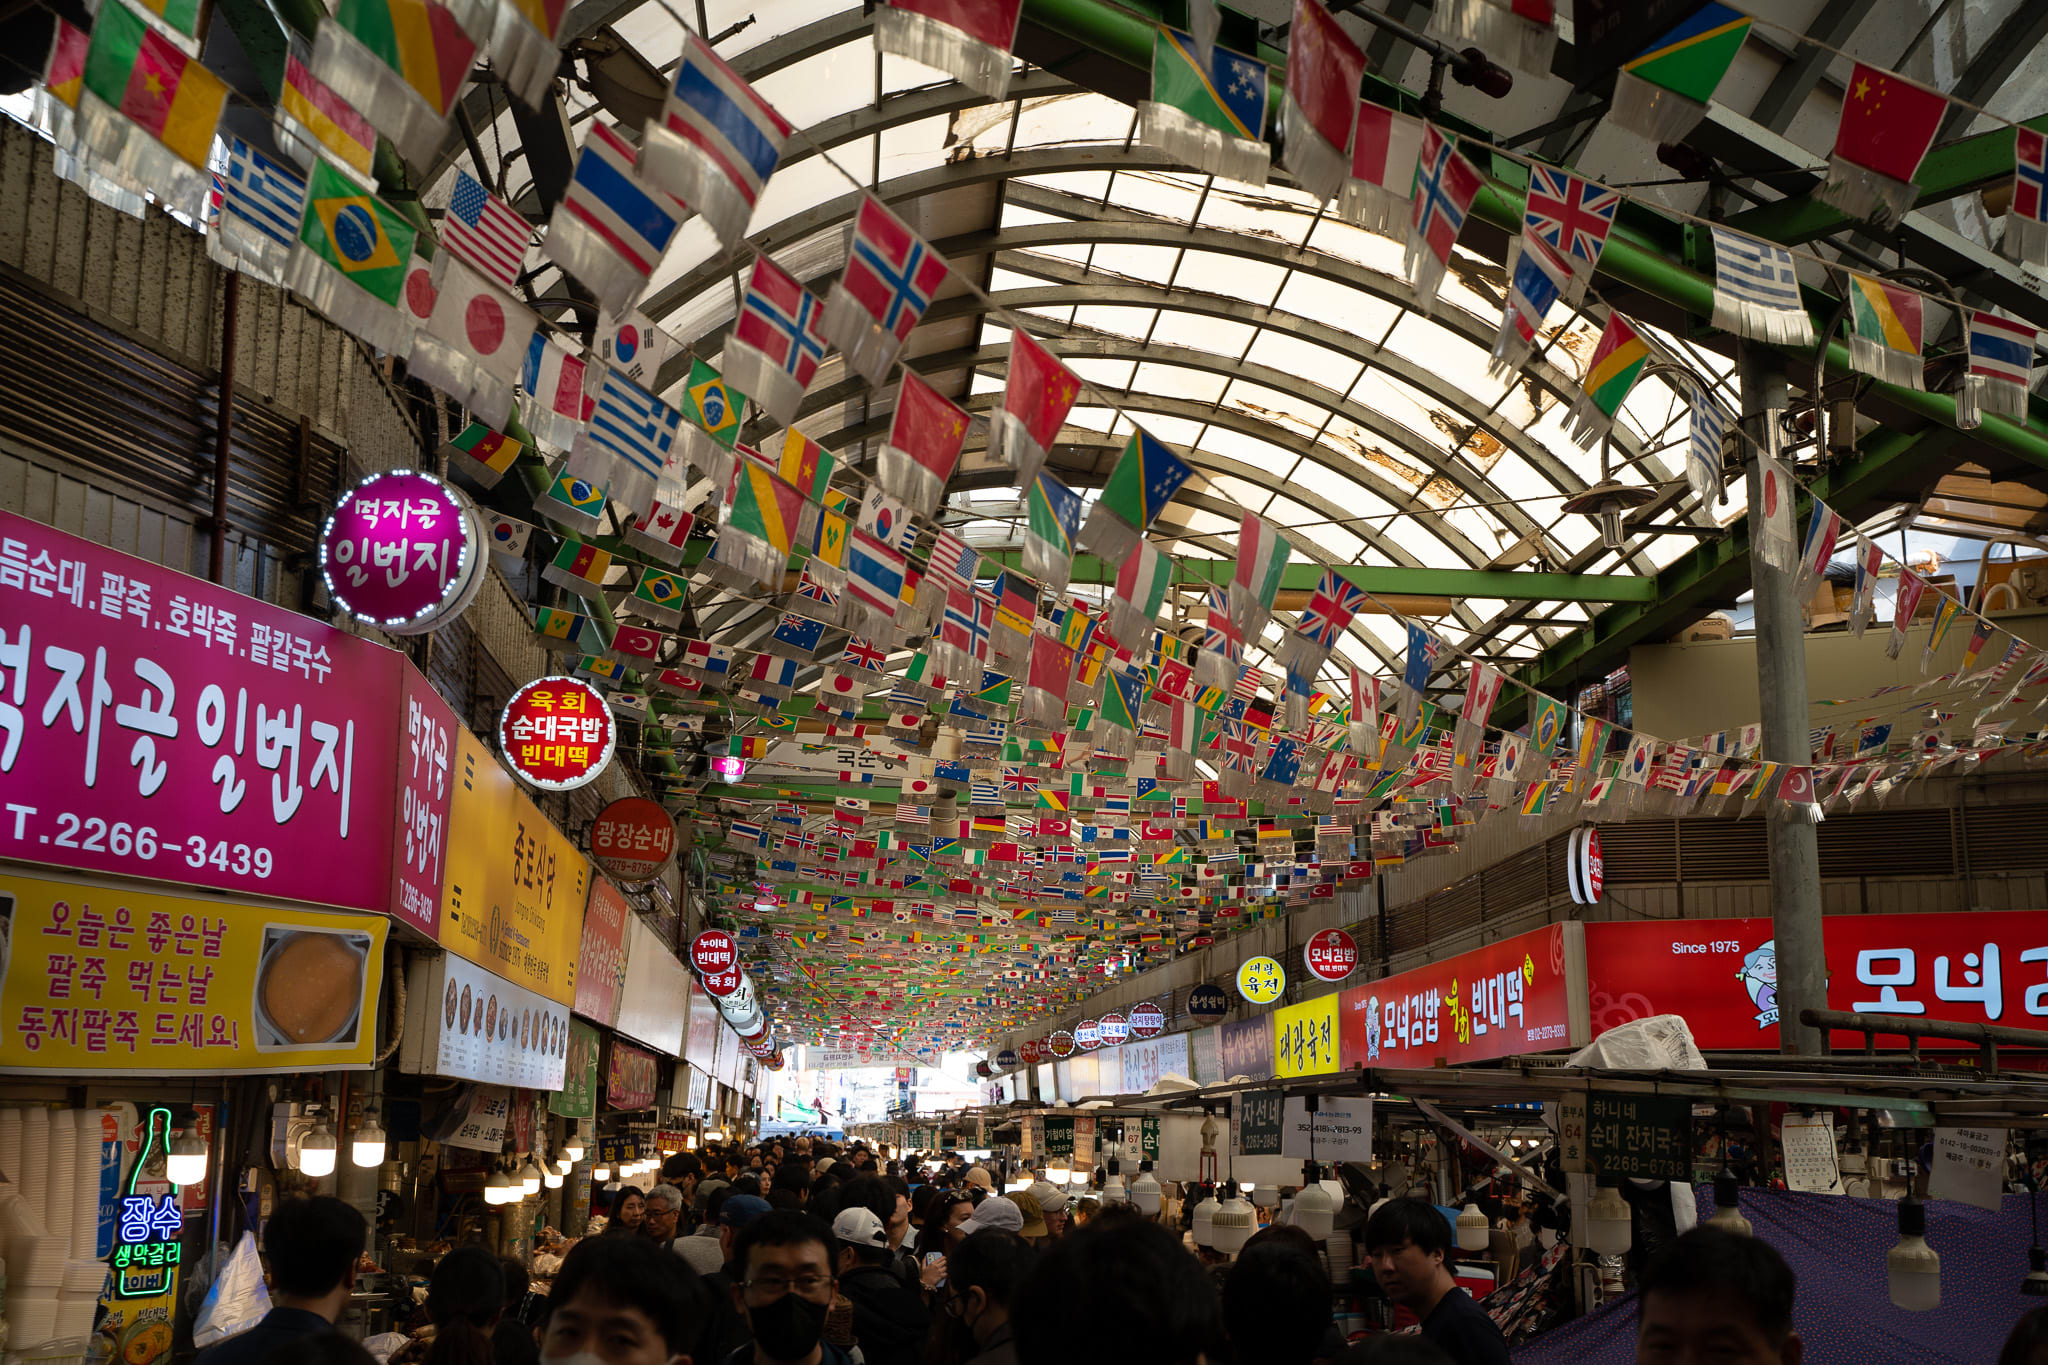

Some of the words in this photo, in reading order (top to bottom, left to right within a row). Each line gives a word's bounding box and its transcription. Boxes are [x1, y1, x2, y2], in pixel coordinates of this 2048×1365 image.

[355, 498, 442, 529] 먹자골
[335, 537, 450, 590] 일번지
[528, 691, 587, 714] 육회
[511, 714, 603, 743] 순대국밥
[196, 684, 355, 840] 일번지
[408, 695, 448, 801] 먹자골
[521, 745, 589, 768] 빈대떡
[837, 748, 894, 770] 국순
[6, 803, 273, 878] T.2266-3439
[403, 785, 442, 885] 일번지
[597, 821, 671, 854] 광장순대
[513, 821, 557, 910] 종로식당
[42, 900, 135, 950] 오늘은
[146, 911, 227, 958] 좋은날
[699, 938, 728, 949] 누이네
[697, 951, 731, 965] 빈대떡
[1311, 947, 1356, 963] 모녀김밥
[1672, 942, 1707, 954] Since
[1709, 940, 1740, 953] 1975
[47, 954, 107, 1000] 팥죽
[128, 960, 215, 1006] 먹는날
[1250, 962, 1275, 976] 대광
[1244, 976, 1279, 995] 육전
[1383, 987, 1441, 1051] 모녀김밥
[1471, 966, 1524, 1036] 빈대떡
[17, 1006, 140, 1052] 동지팥죽
[151, 1012, 239, 1050] 드세요!
[1280, 1014, 1331, 1071] 대광육전
[1242, 1098, 1280, 1128] 자선네
[1592, 1099, 1637, 1121] 하니네
[1128, 1134, 1139, 1143] 67
[1565, 1124, 1582, 1139] 64
[1590, 1121, 1620, 1150] 순대
[1567, 1145, 1579, 1159] 호
[1603, 1154, 1686, 1177] 2268-6738
[121, 1196, 182, 1241] 장수
[115, 1241, 181, 1267] 생막걸리
